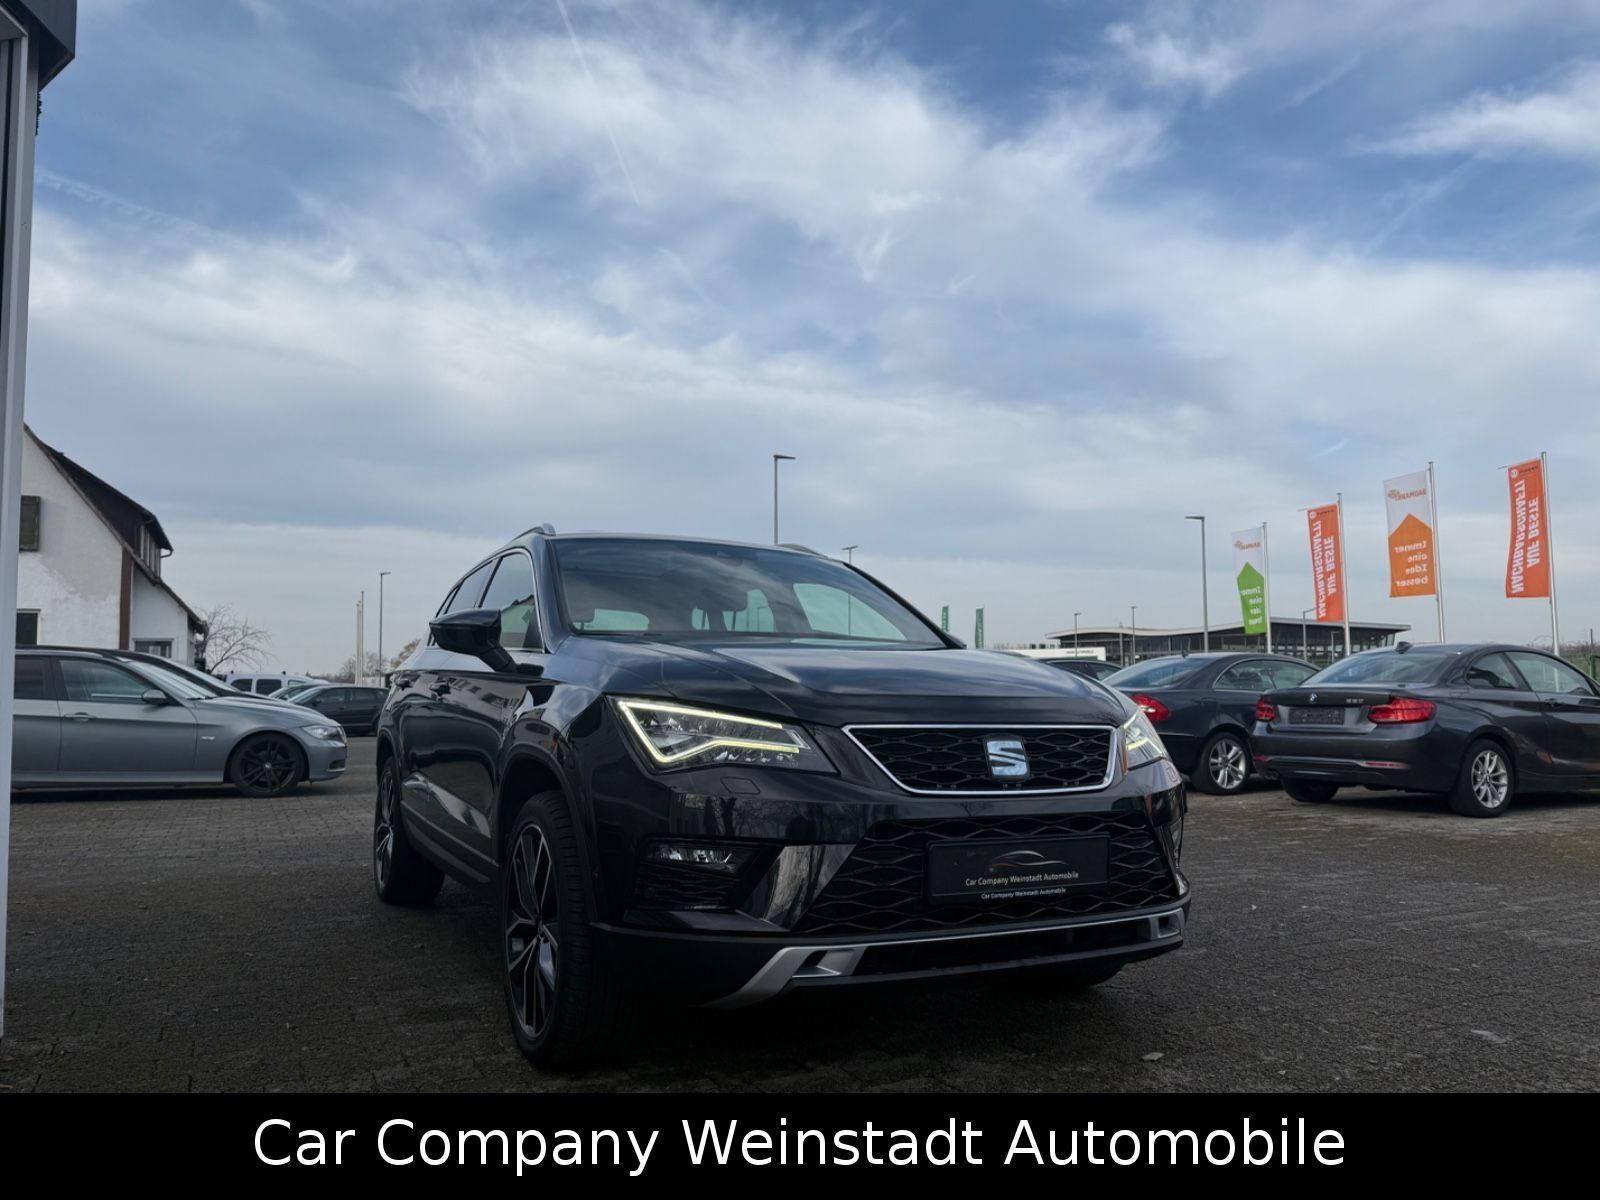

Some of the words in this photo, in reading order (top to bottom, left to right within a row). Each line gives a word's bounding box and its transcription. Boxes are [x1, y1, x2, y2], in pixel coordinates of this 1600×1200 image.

[965, 878, 977, 886] Car
[978, 877, 1008, 885] Company
[1010, 874, 1042, 883] Weinstadt
[1043, 871, 1078, 880] Automobile
